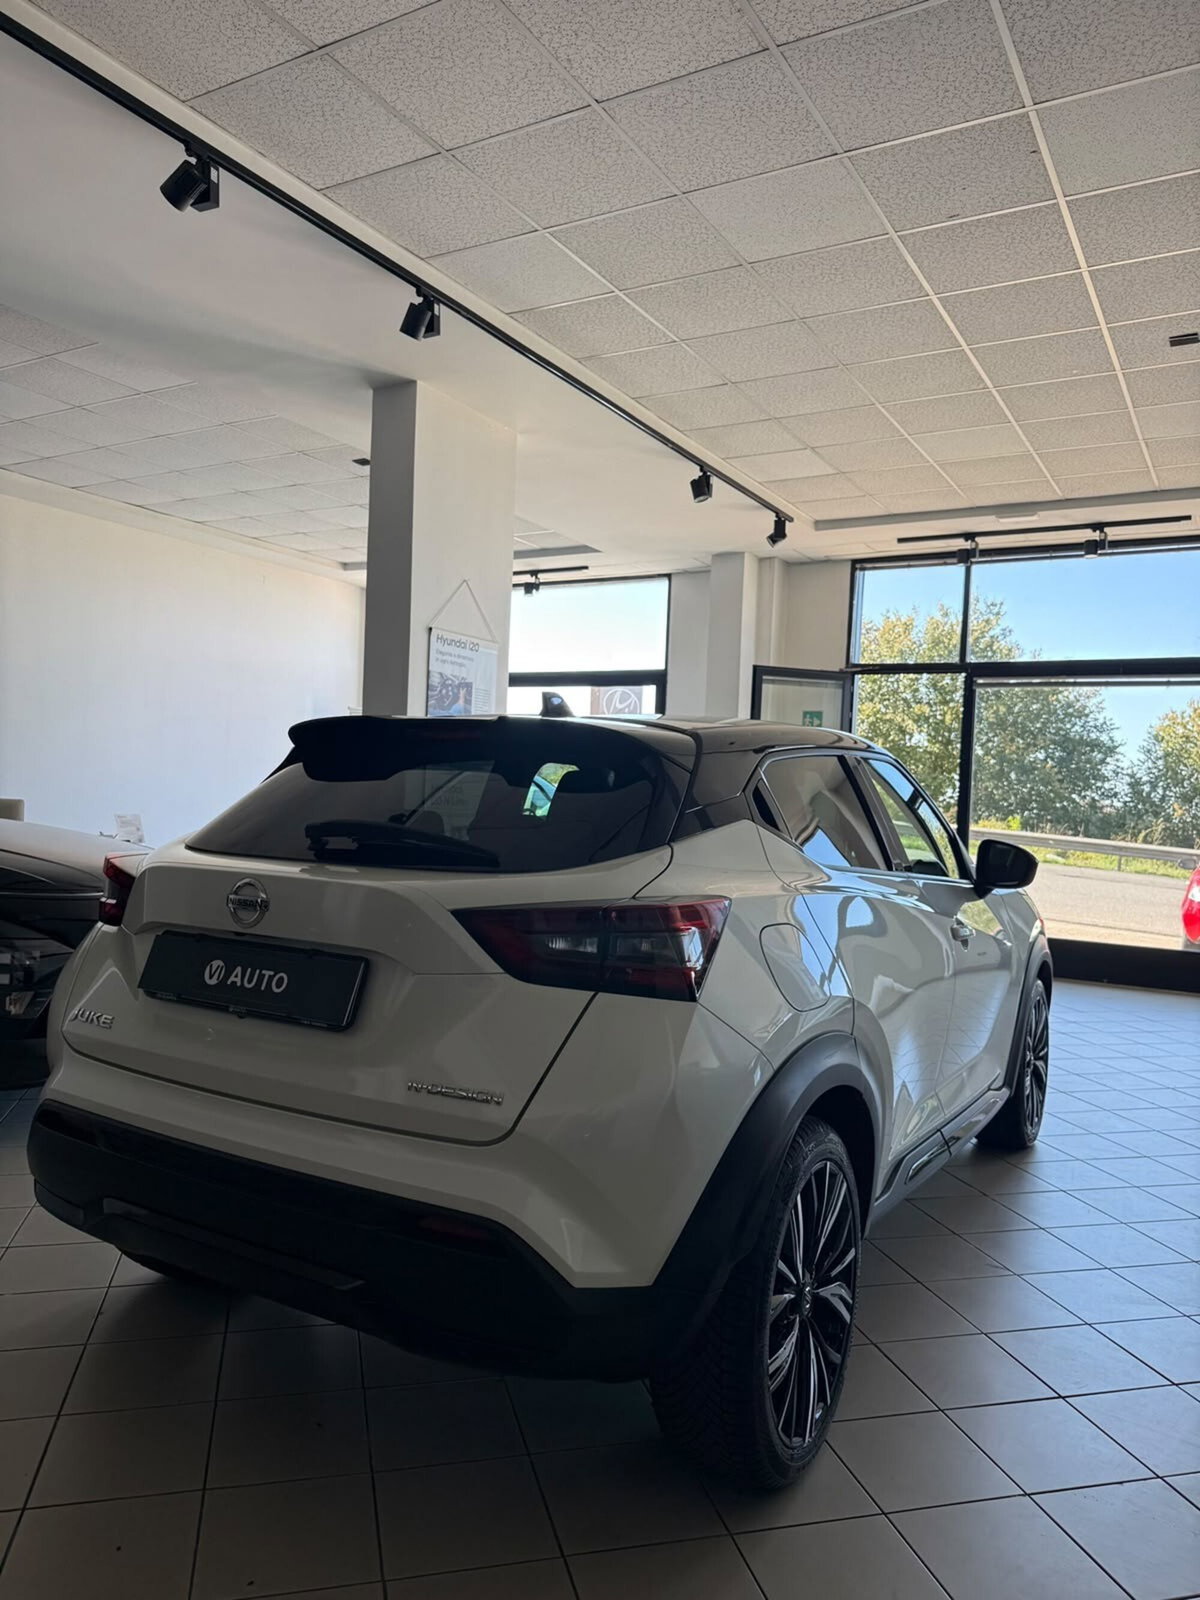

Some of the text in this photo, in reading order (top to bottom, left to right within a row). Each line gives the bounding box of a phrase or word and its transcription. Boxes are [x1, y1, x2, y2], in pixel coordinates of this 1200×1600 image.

[436, 634, 480, 652] Hyundai i20
[228, 896, 265, 911] NISSAN
[227, 965, 288, 993] AUTO
[69, 1007, 115, 1030] JUKE
